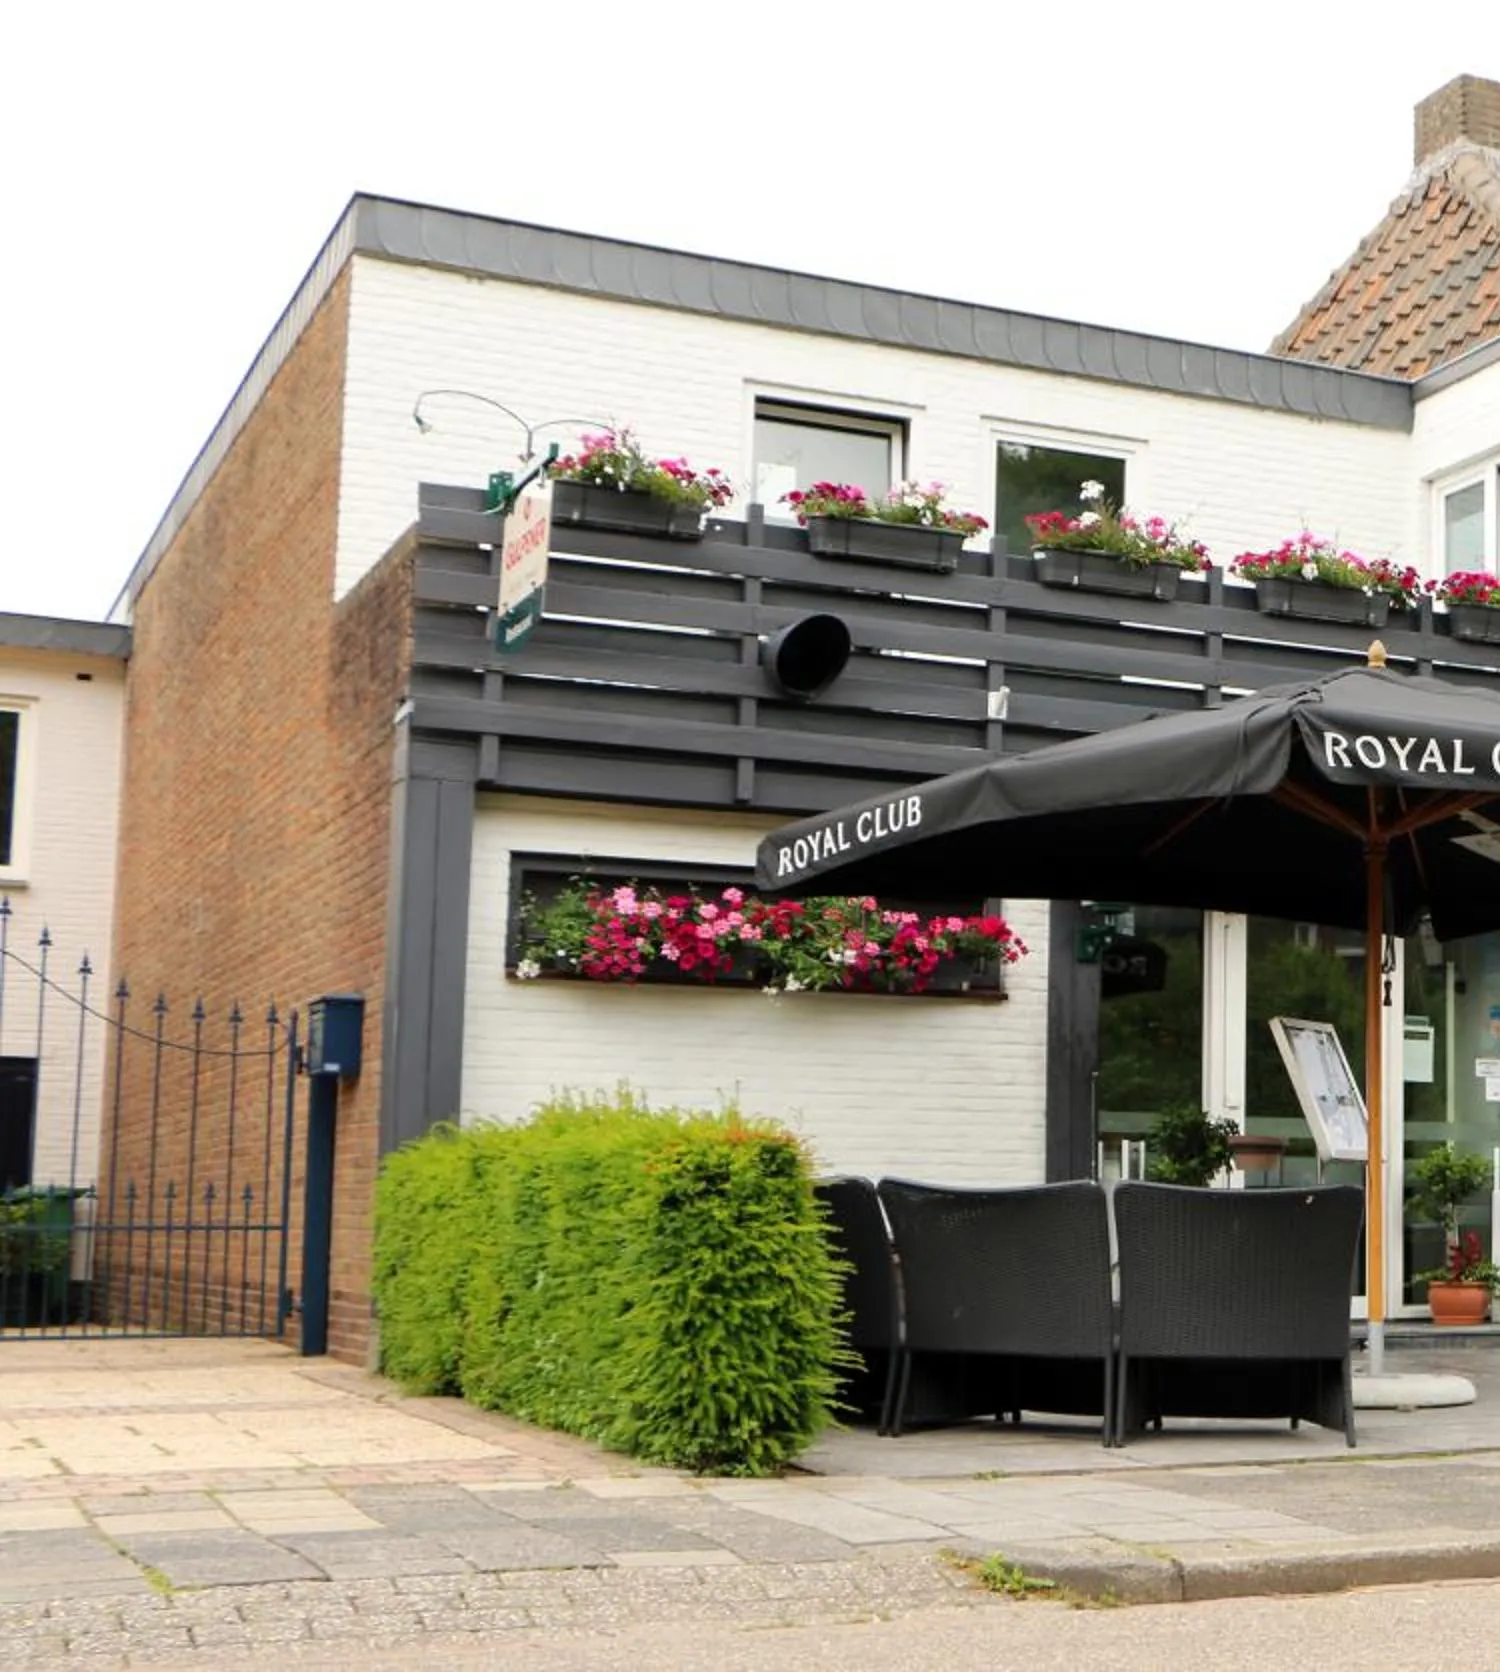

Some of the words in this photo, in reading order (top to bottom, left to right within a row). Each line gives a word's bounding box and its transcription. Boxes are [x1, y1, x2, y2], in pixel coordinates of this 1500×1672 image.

[1323, 730, 1475, 775] ROYAL
[776, 821, 851, 877] ROYAL
[856, 795, 922, 843] CLUB
